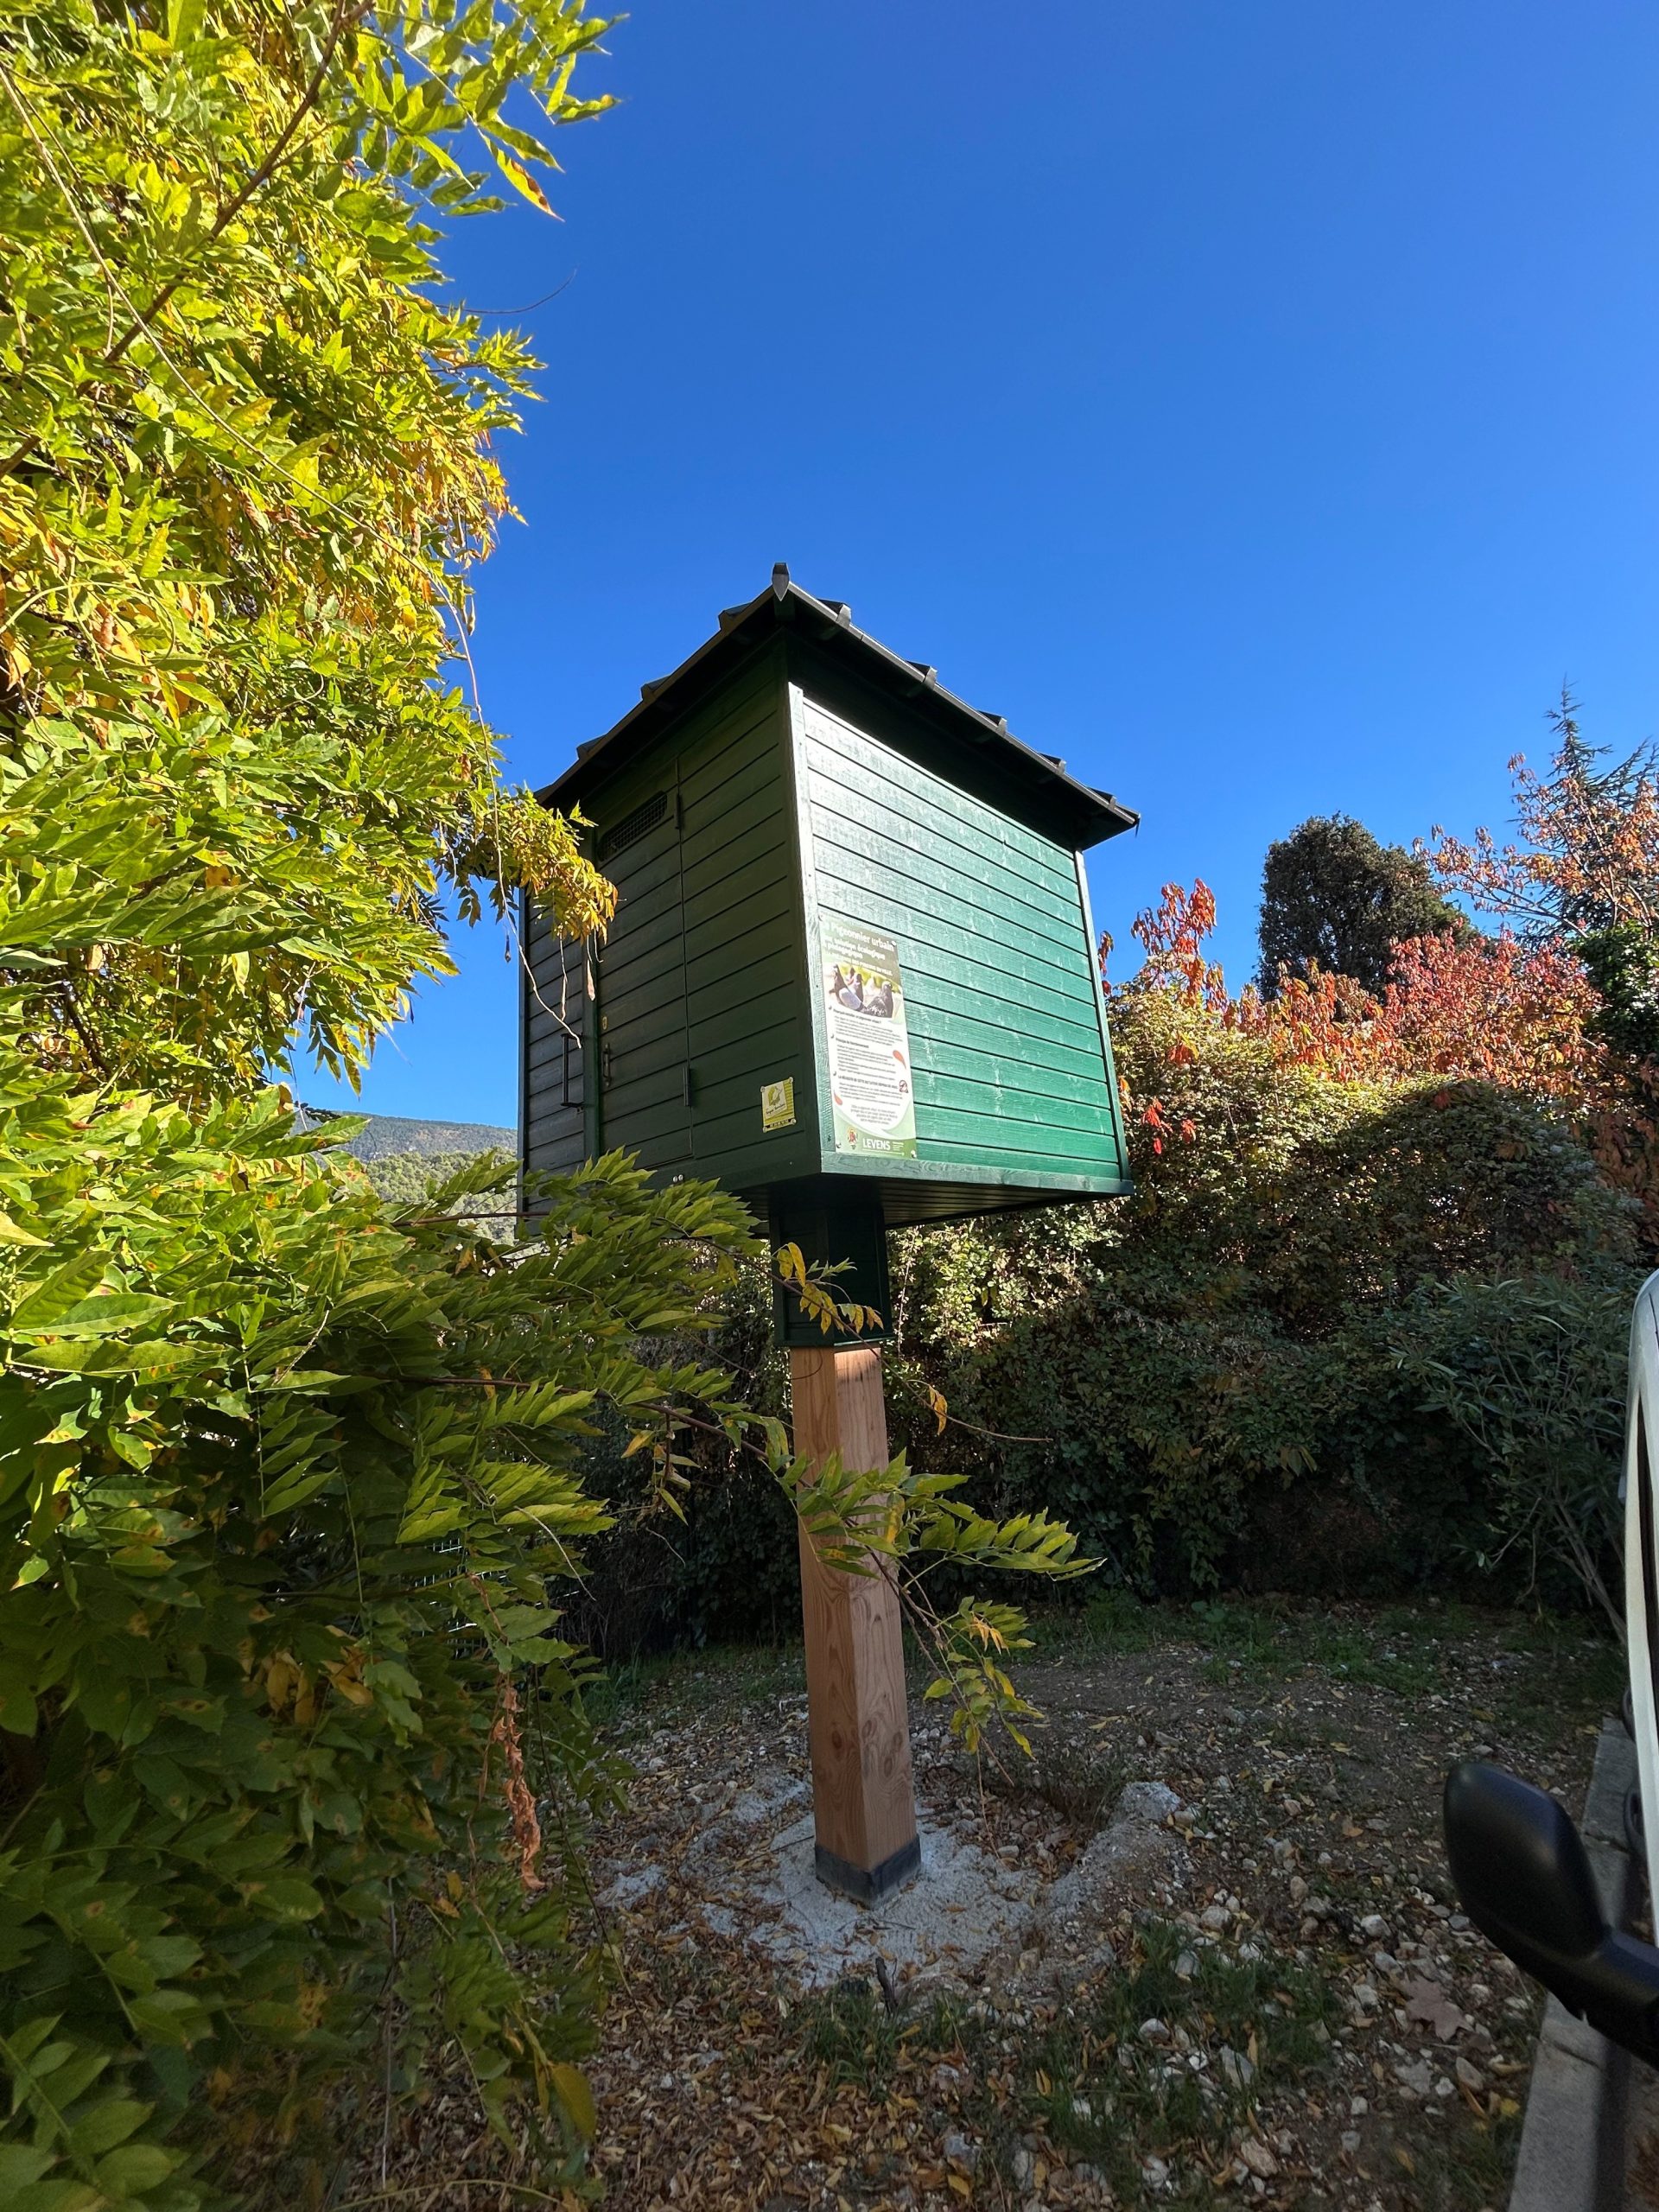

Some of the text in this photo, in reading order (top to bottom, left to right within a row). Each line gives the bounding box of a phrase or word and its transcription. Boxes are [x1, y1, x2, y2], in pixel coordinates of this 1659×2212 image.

[831, 924, 871, 944] Pigeonnier
[871, 938, 894, 952] urbain
[862, 1138, 891, 1151] LEVENS
